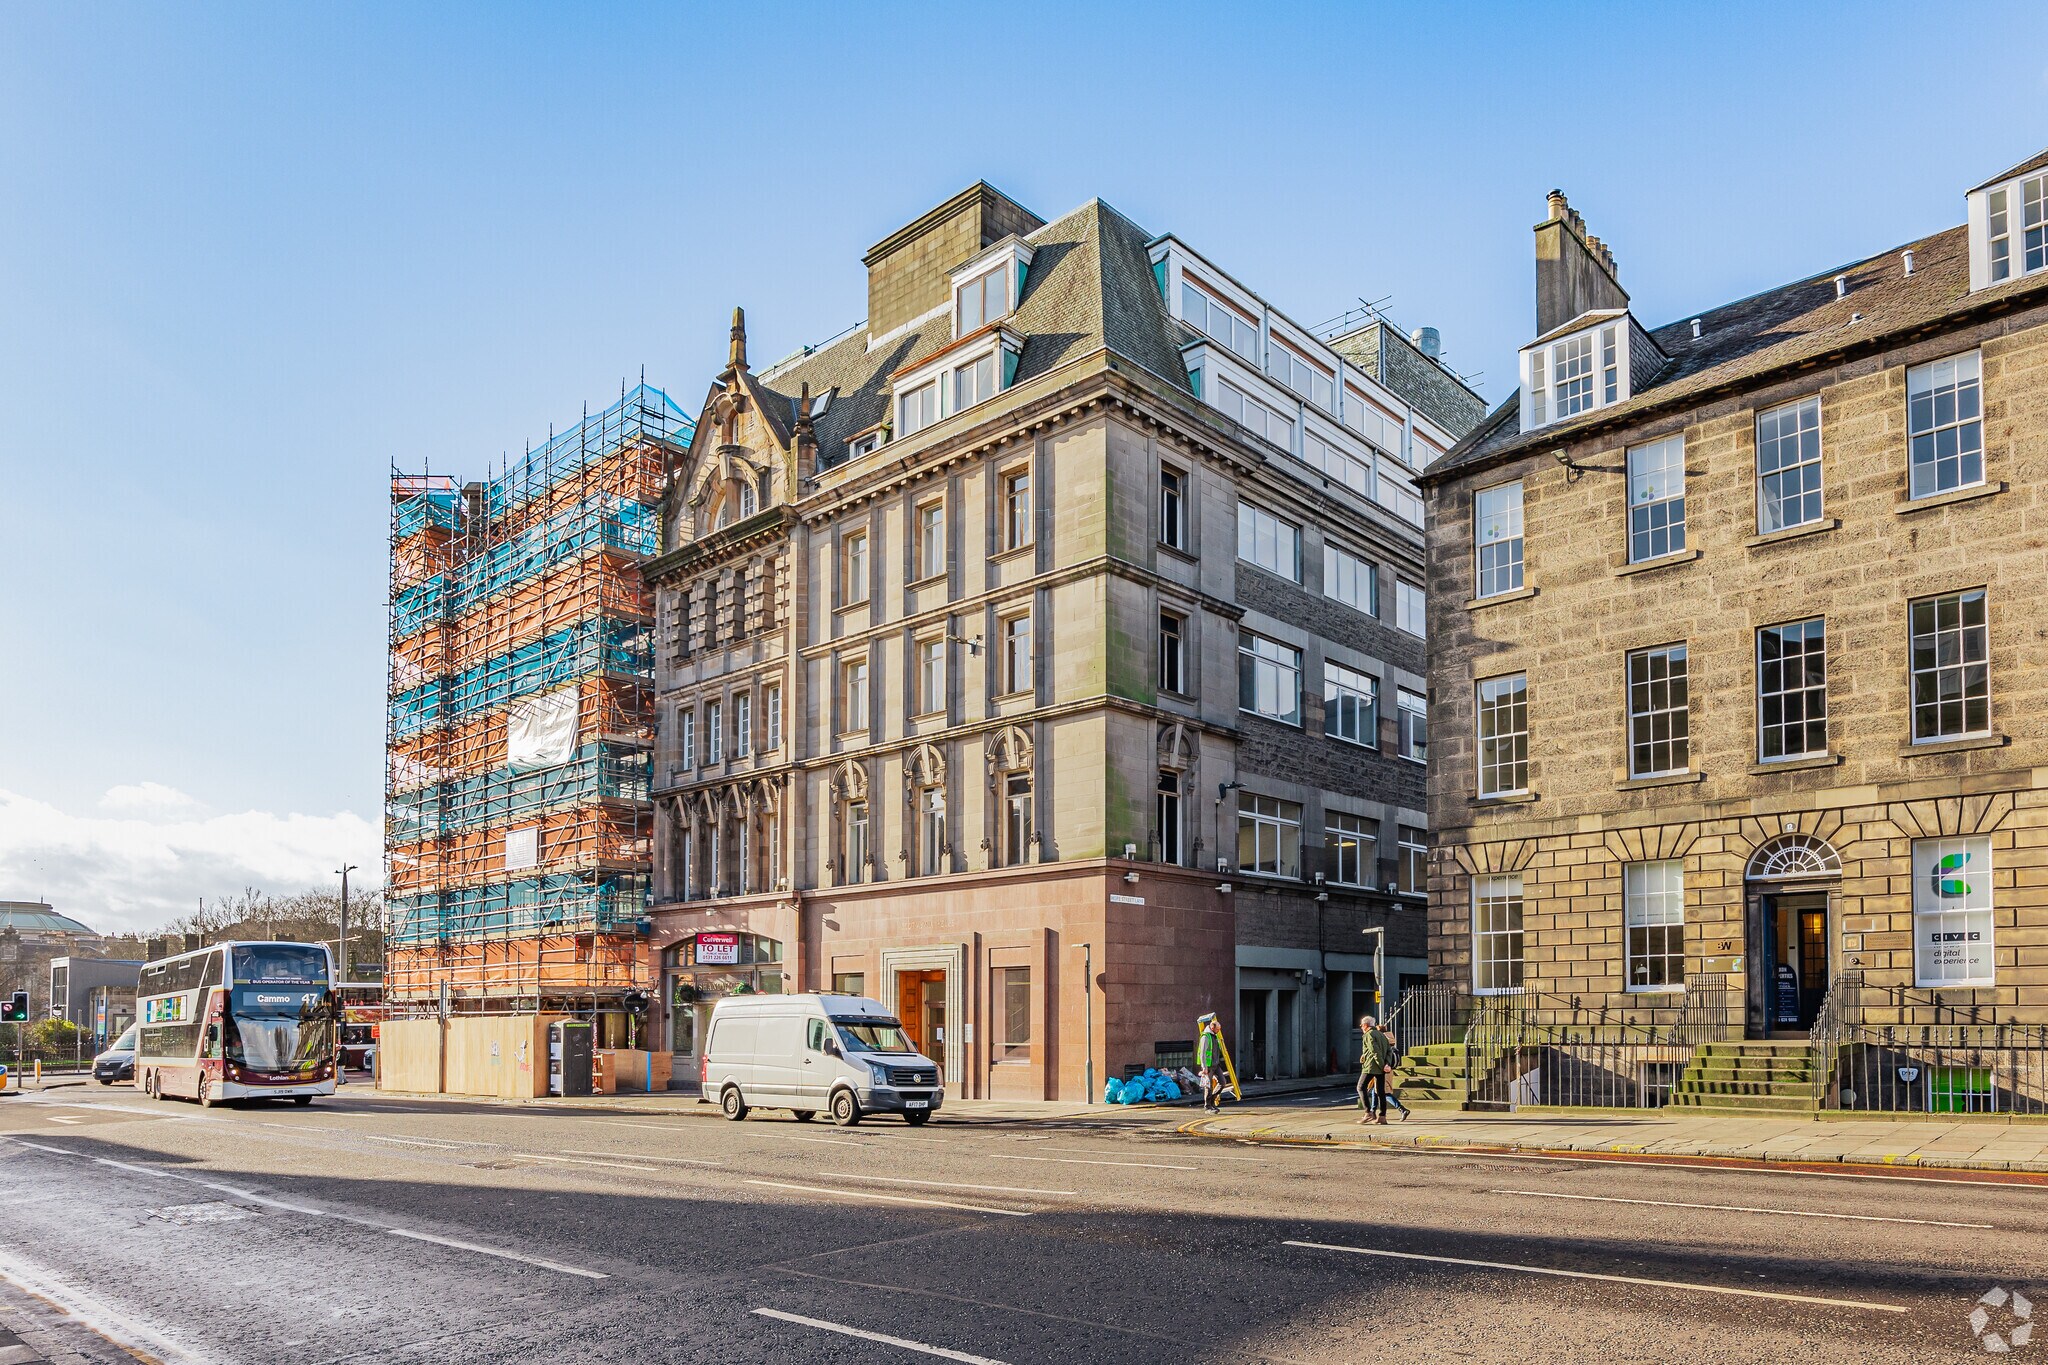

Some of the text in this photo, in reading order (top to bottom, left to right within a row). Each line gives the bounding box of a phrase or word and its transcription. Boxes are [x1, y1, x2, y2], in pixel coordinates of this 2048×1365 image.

[1933, 949, 1961, 958] digital
[1933, 957, 1980, 965] experience
[257, 993, 318, 1004] Cammo 47
